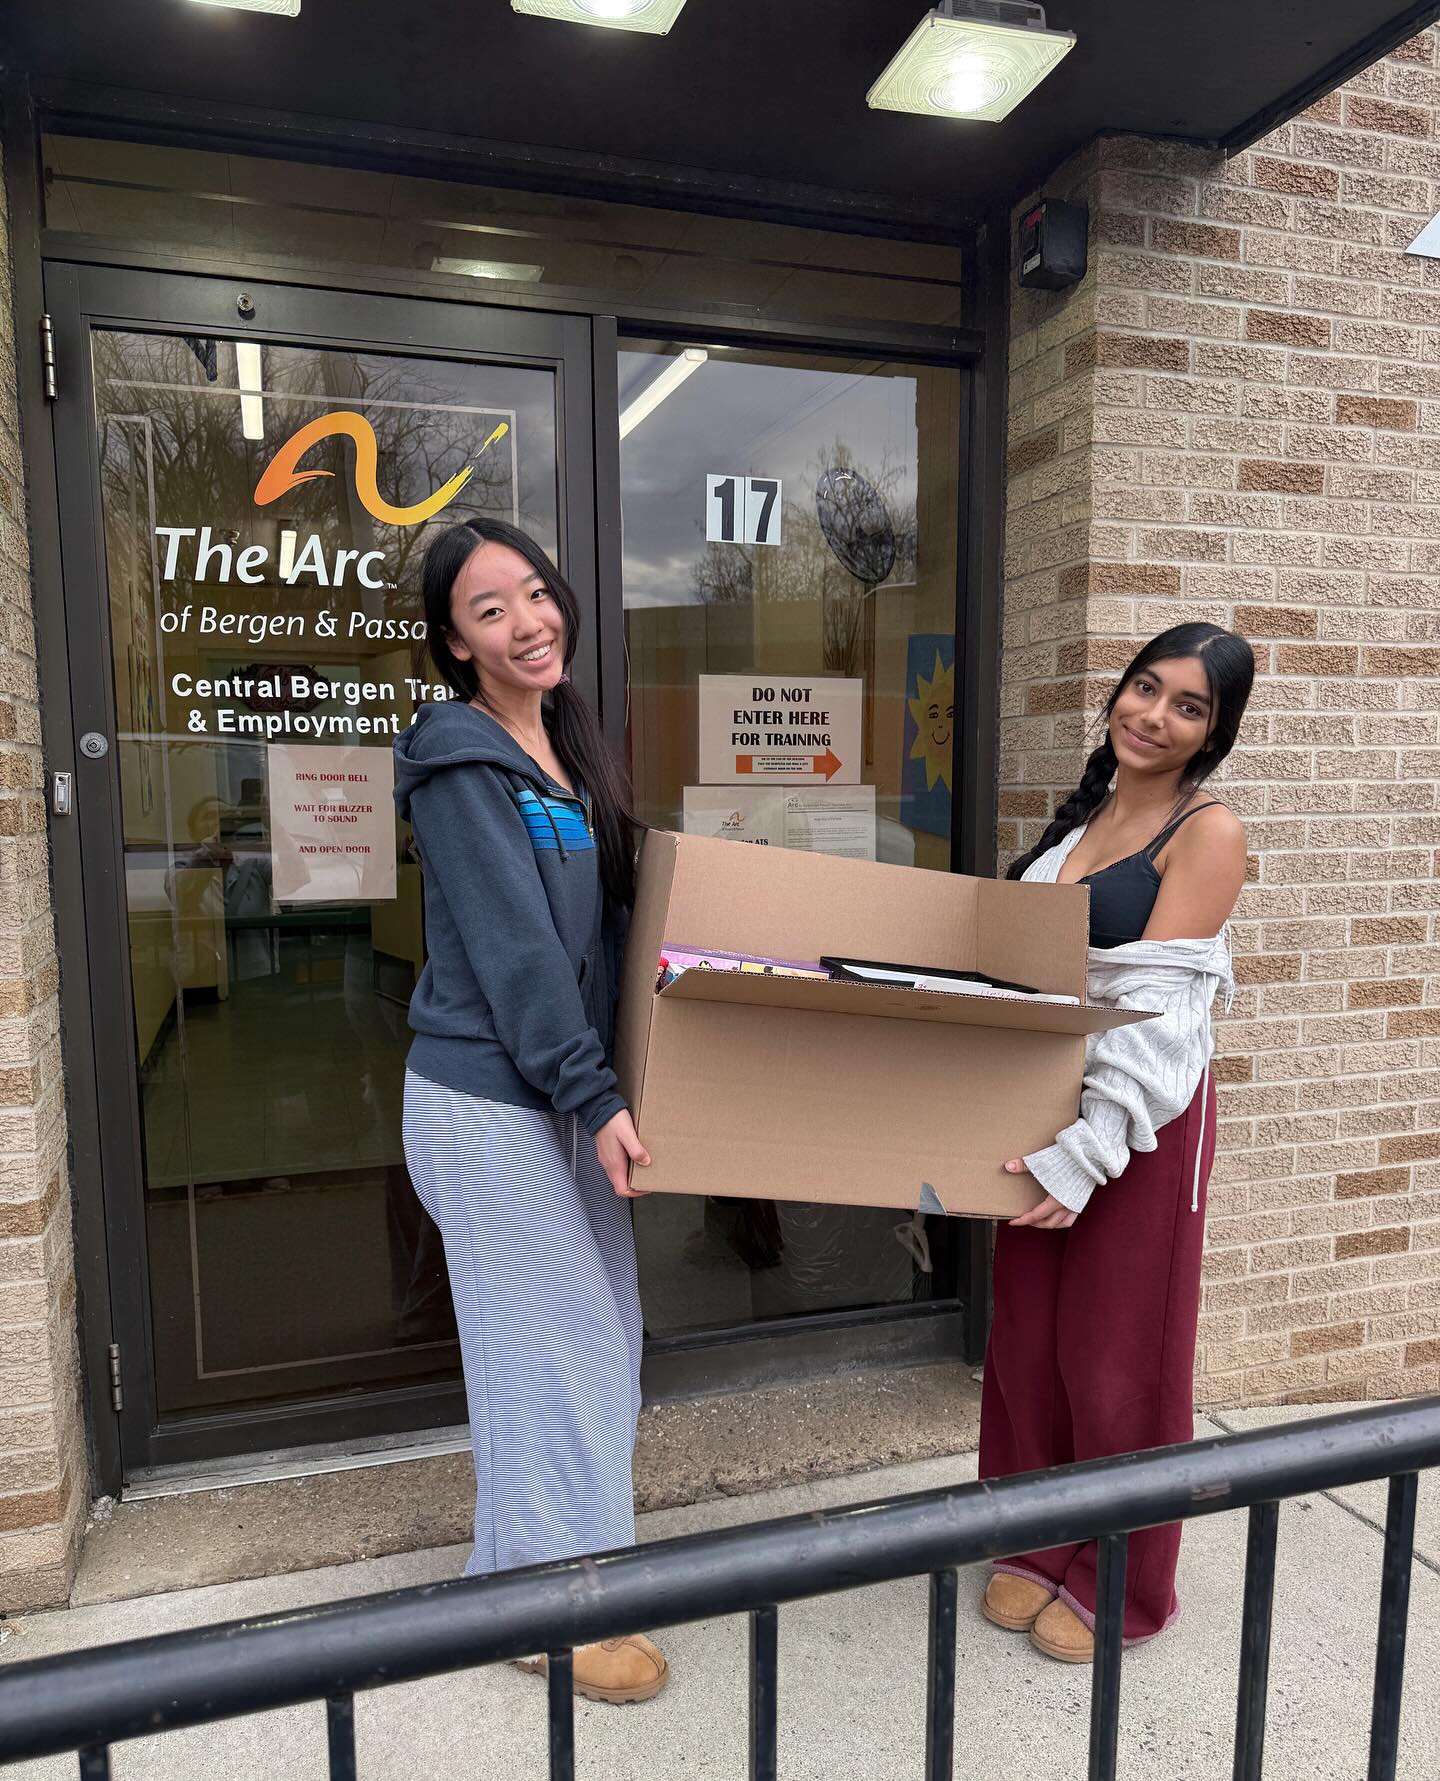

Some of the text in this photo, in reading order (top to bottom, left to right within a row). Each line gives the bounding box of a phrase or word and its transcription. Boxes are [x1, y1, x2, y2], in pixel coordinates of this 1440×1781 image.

[714, 478, 778, 543] 17
[155, 526, 269, 584] The
[286, 534, 386, 589] Arc
[160, 605, 429, 644] of Bergen & Passa
[172, 673, 281, 698] Central
[291, 675, 395, 705] Bergen
[752, 687, 812, 703] DO NOT
[187, 709, 208, 733] &
[217, 709, 400, 739] Employment
[733, 709, 830, 726] ENTER HERE
[731, 732, 832, 747] FOR TRAINING
[295, 773, 369, 783] RING DOOR BELL
[293, 804, 373, 813] WAIT FOR BUZZER
[313, 815, 358, 823] TO SOUND
[299, 845, 371, 854] AND OPEN DOOR
